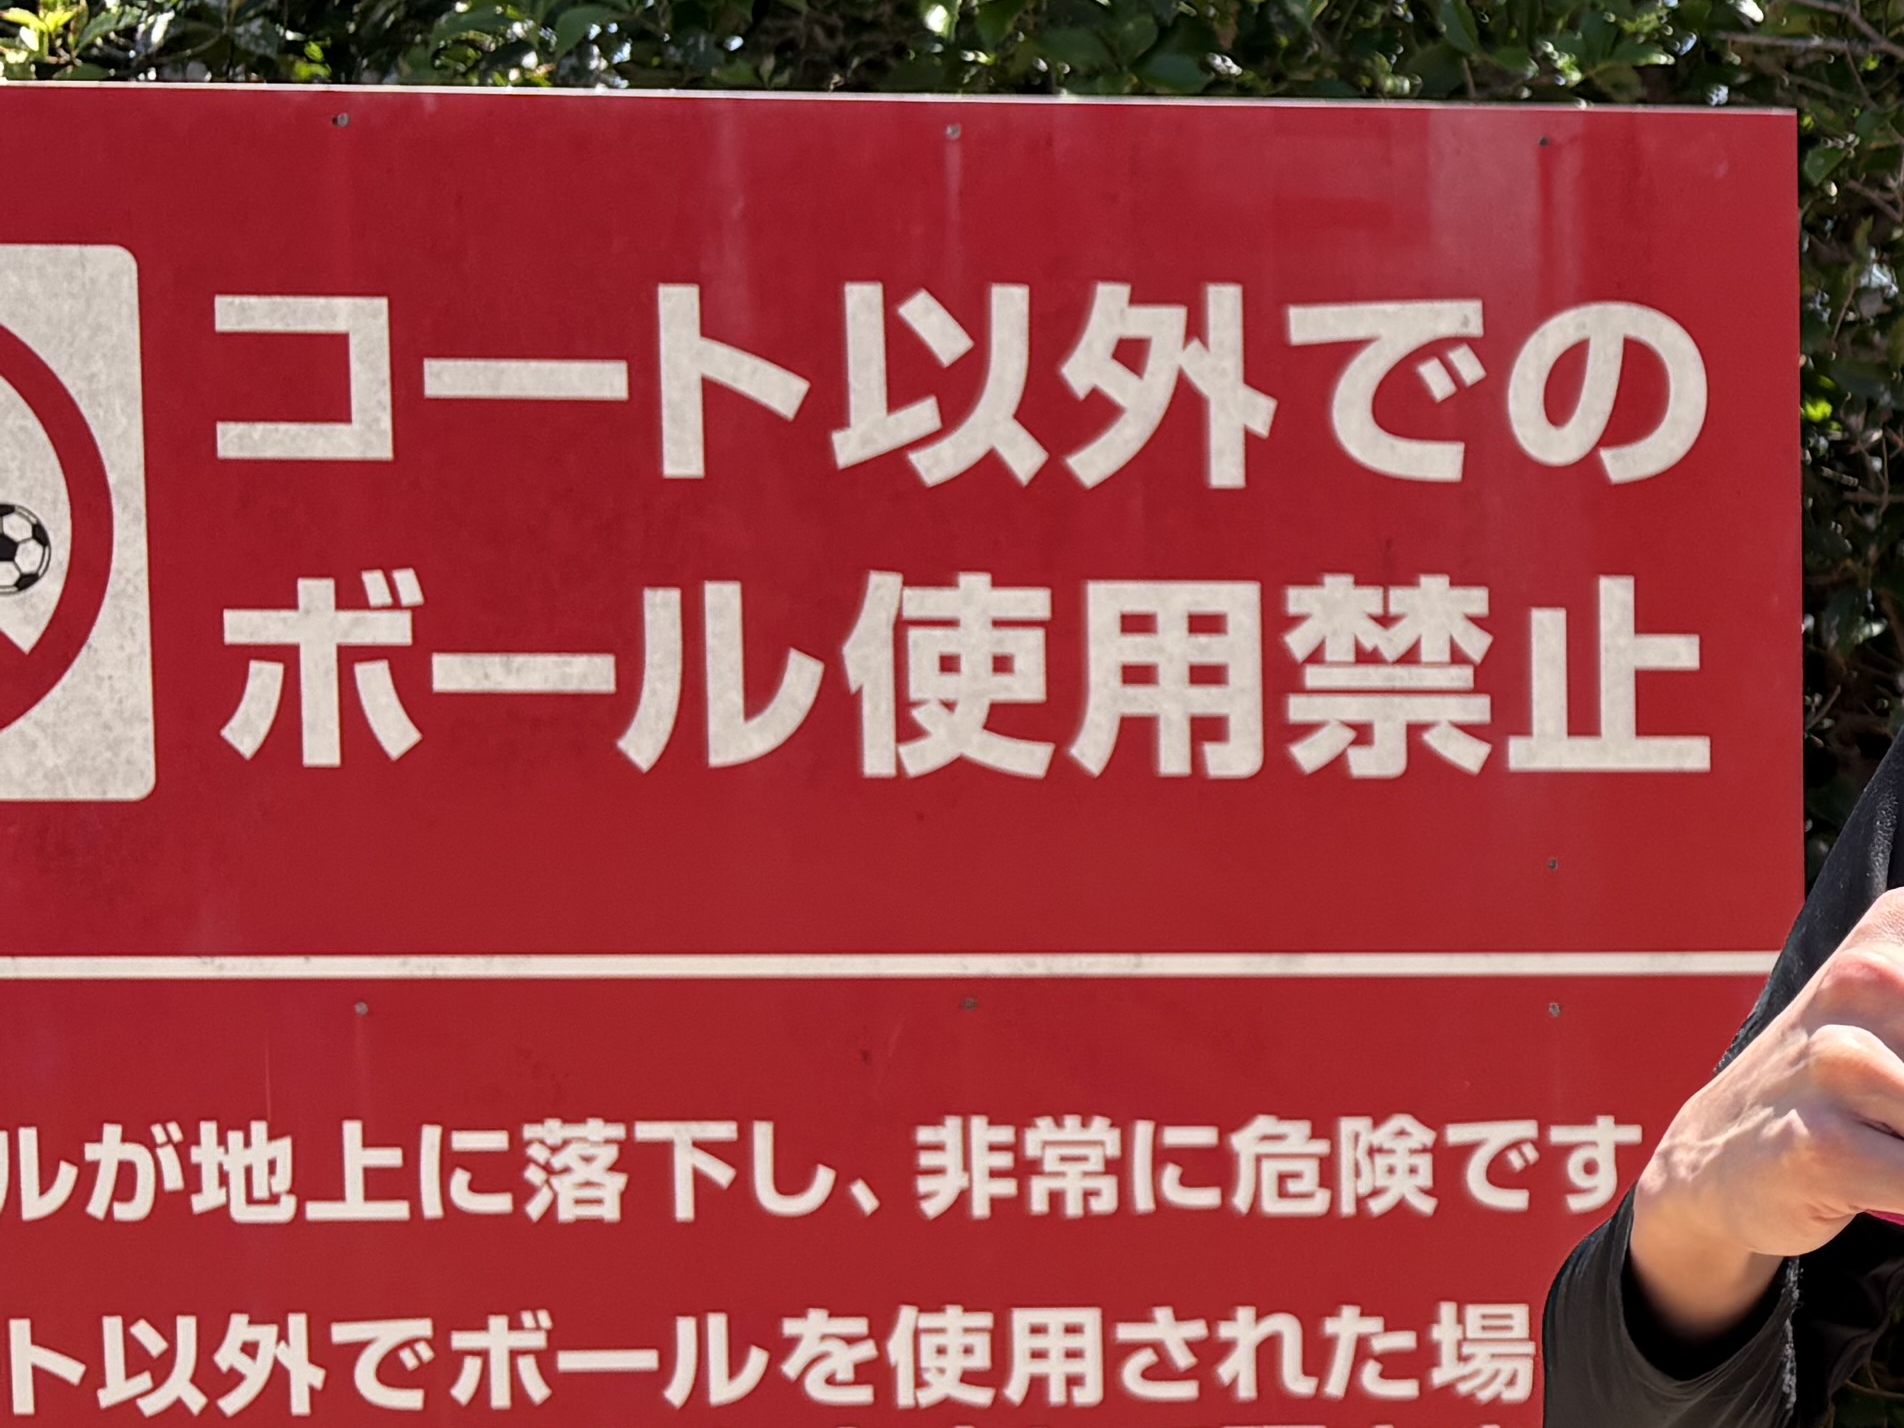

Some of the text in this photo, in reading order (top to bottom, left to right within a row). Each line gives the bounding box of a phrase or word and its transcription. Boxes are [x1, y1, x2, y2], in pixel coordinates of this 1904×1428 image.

[214, 282, 1708, 489] コート以外での
[220, 568, 1711, 779] ボール使用禁止
[0, 1114, 1643, 1224] ルが地上に落下し、非常に危険です
[8, 1301, 1537, 1418] ト以外でボールを使用された場
